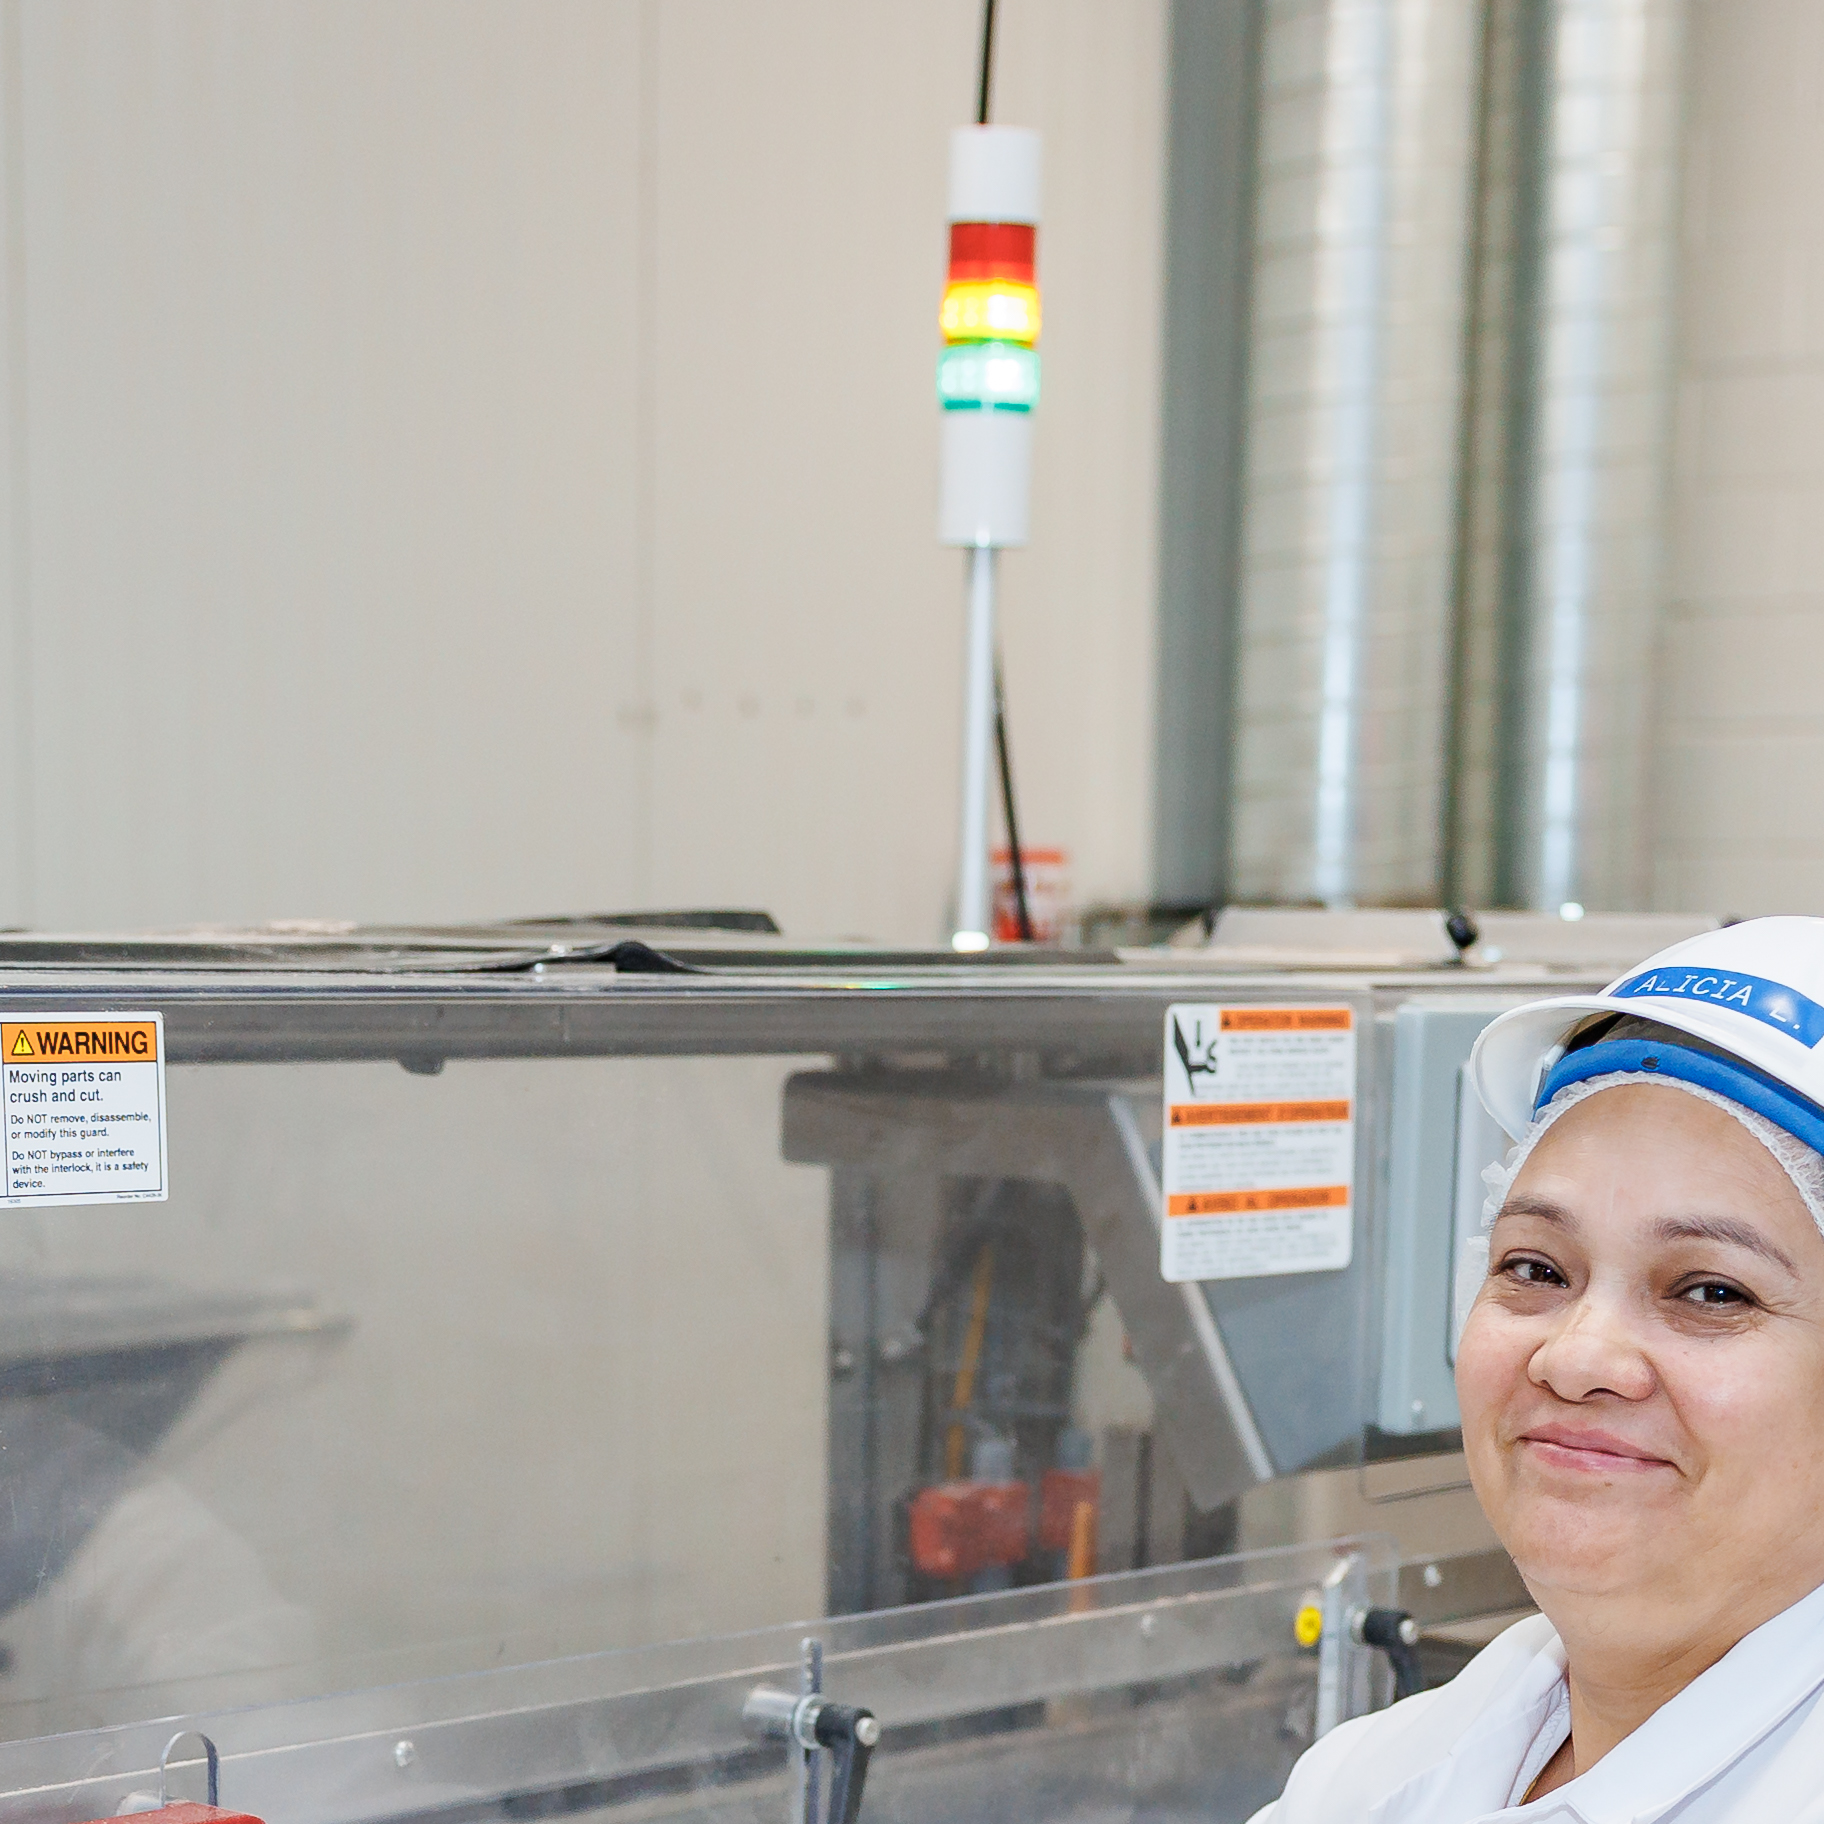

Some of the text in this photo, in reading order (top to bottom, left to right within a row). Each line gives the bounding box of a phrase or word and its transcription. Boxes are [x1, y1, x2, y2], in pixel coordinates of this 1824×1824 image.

[1633, 974, 1753, 1007] ALICIA
[36, 1030, 149, 1055] WARNING
[9, 1069, 122, 1086] Moving parts can
[10, 1088, 104, 1103] crush and cut.
[10, 1112, 152, 1125] Do NOT remove, disassemble,
[10, 1127, 110, 1141] or modify this guard.
[12, 1147, 135, 1161] Do NOT bypass or interfere
[12, 1161, 149, 1174] with the interlock, it is a safety
[12, 1178, 46, 1189] device.
